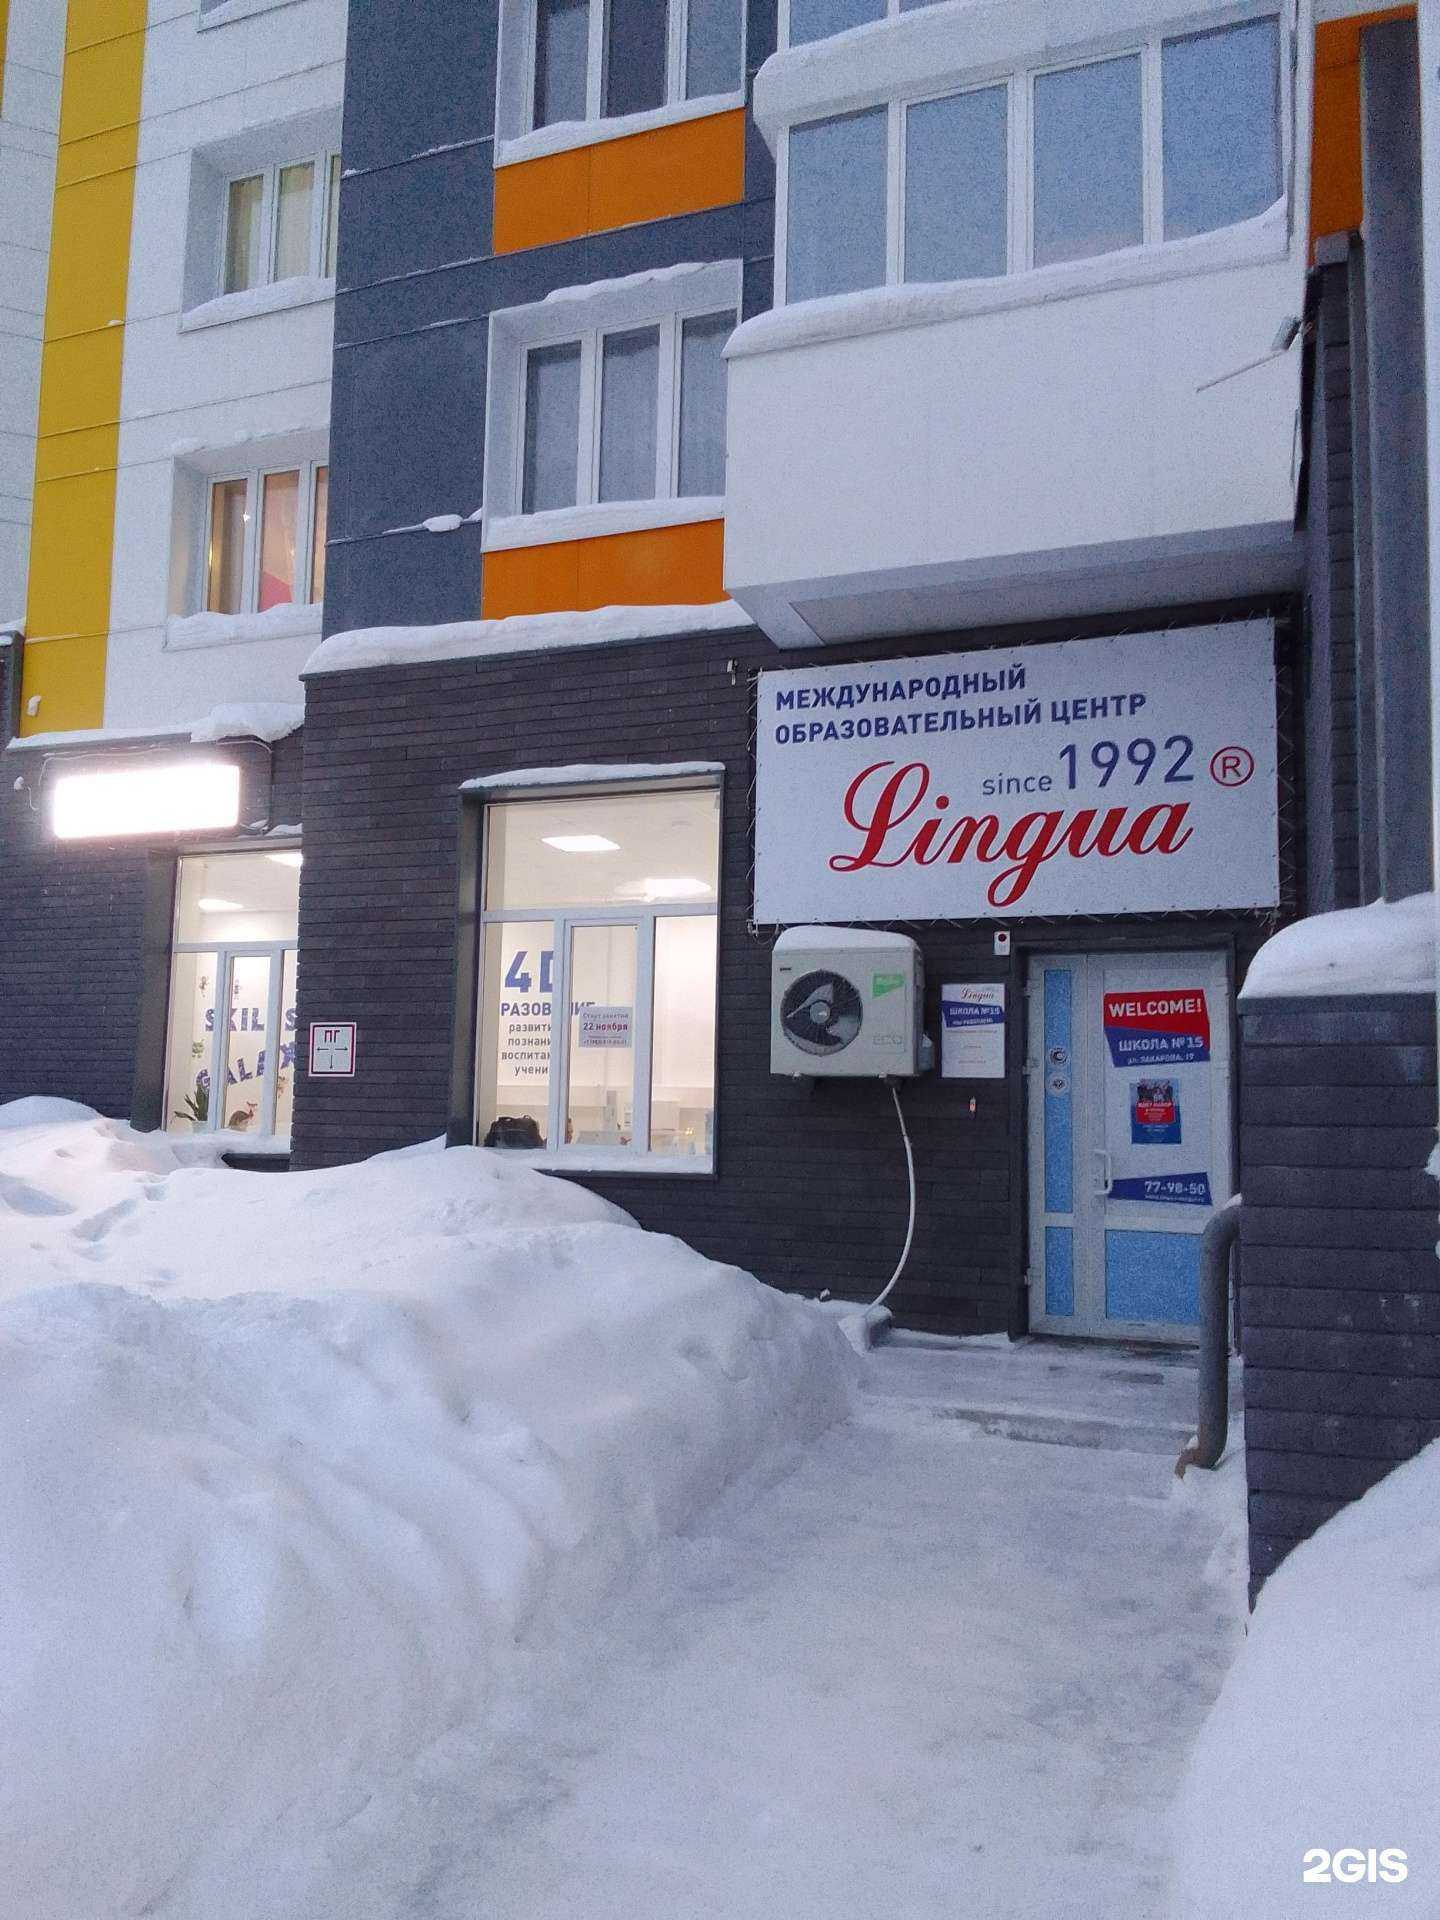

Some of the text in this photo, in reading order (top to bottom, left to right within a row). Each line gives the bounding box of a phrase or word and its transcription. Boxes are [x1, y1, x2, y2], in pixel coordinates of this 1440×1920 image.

[775, 662, 1026, 711] МЕЖДУНАРОДНЫЙ
[775, 693, 1147, 744] ОБРАЗОВАТЕЛЬНЫЙ ЦЕНТР
[982, 771, 1052, 796] since
[1059, 734, 1195, 790] 1992
[829, 760, 1194, 908] Lingua
[1108, 998, 1203, 1018] WELCOME!
[324, 1029, 341, 1043] ПГ
[583, 1022, 628, 1032] 22 ноября
[1119, 1038, 1168, 1051] ШКОЛА
